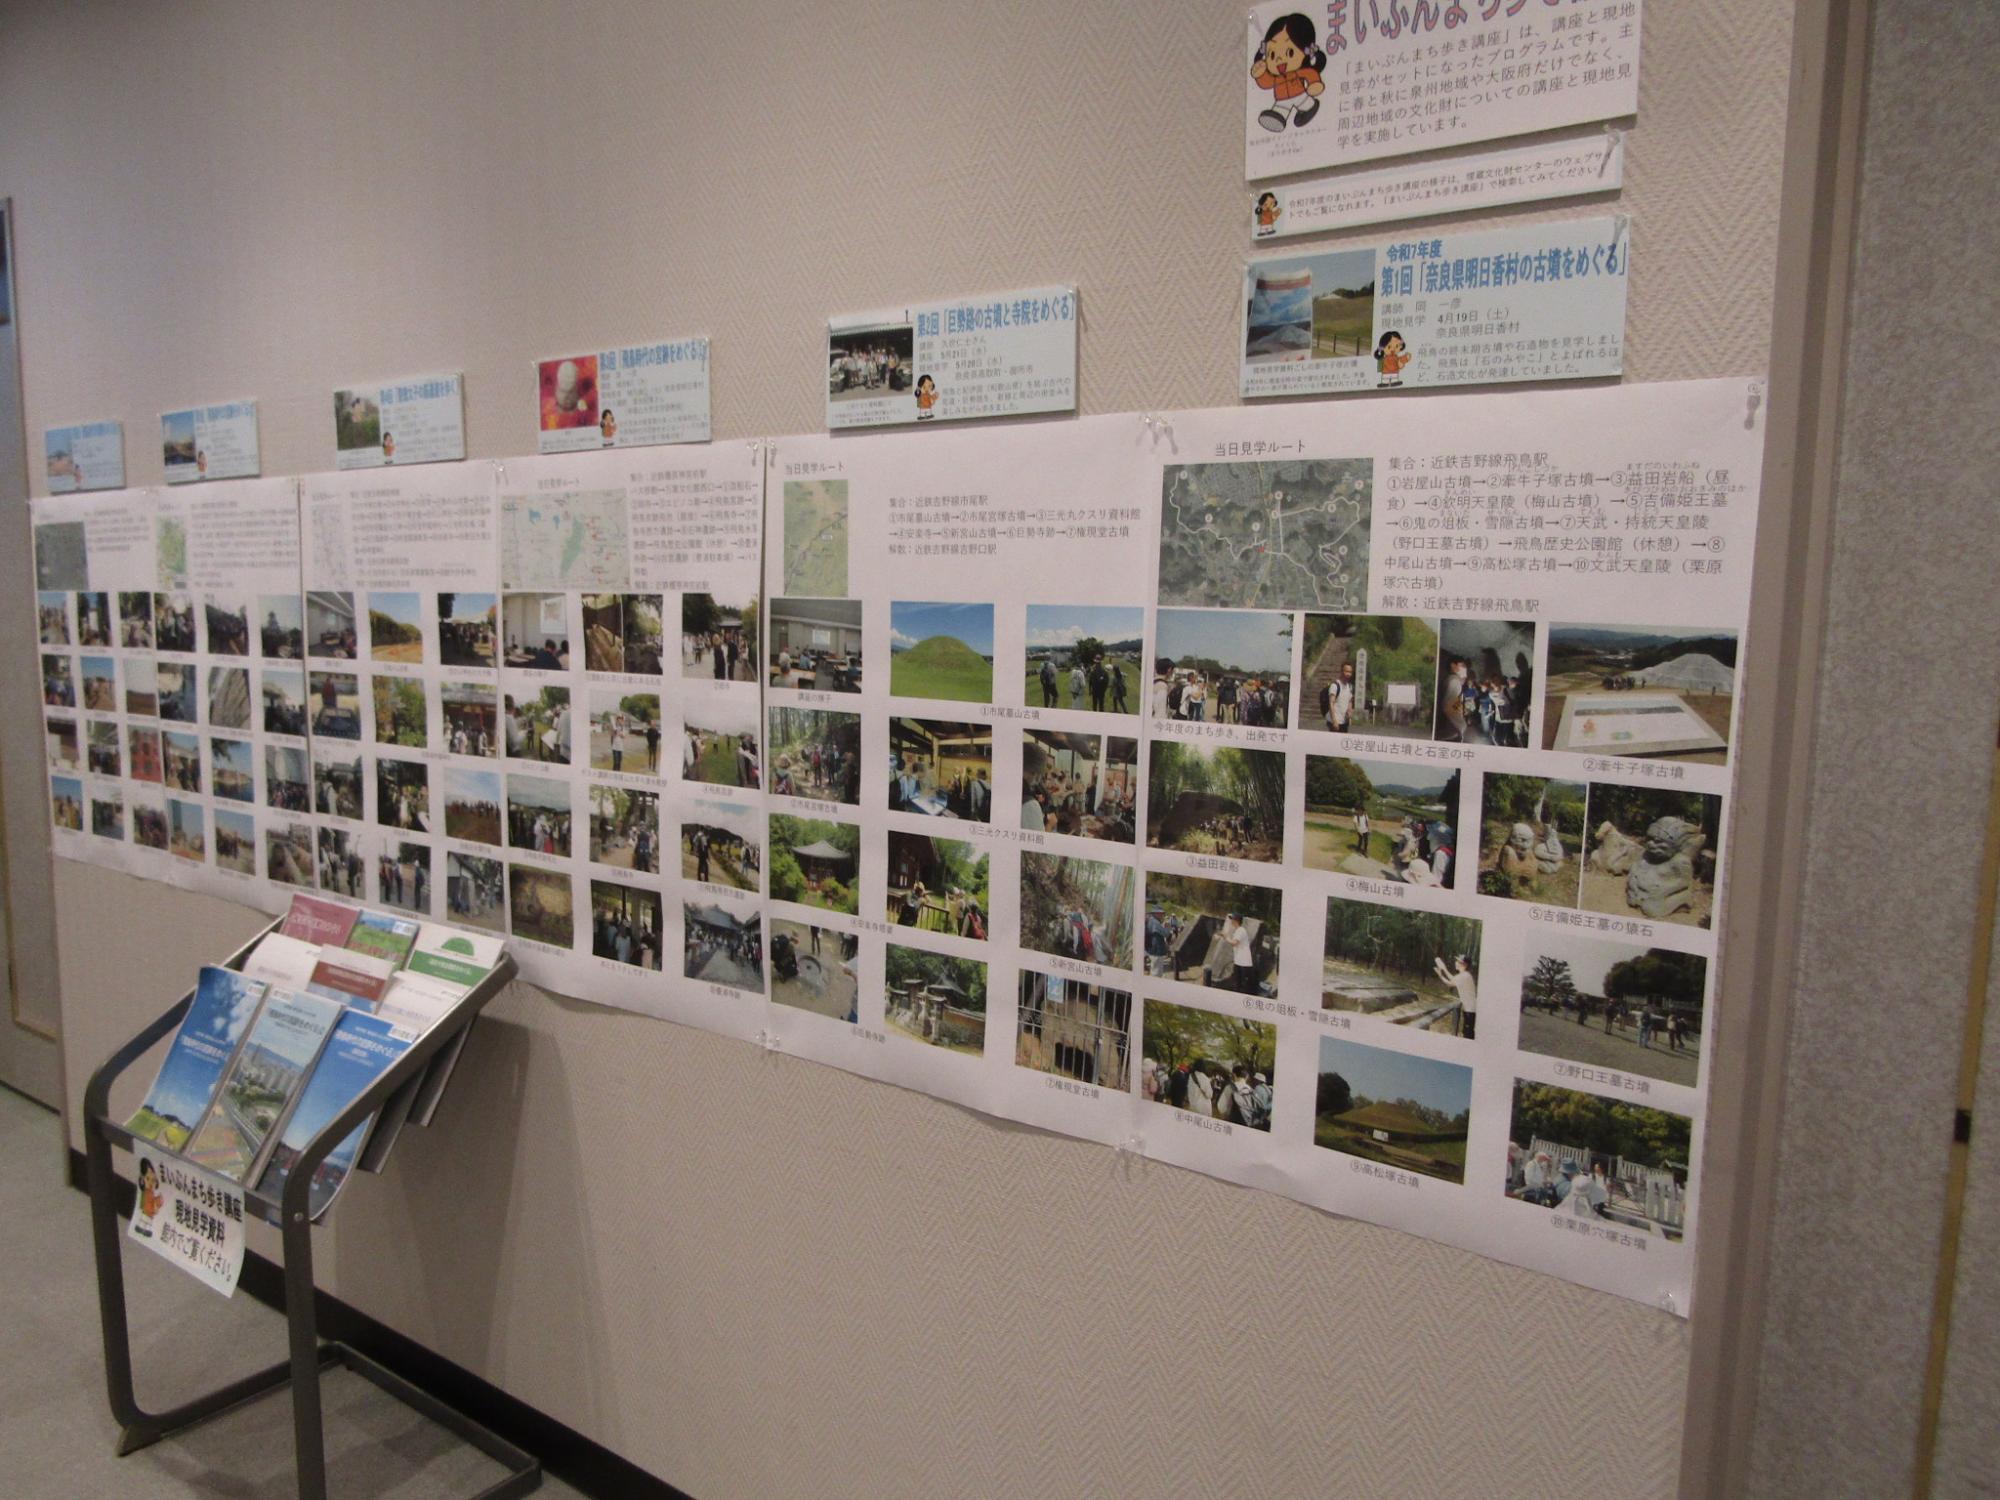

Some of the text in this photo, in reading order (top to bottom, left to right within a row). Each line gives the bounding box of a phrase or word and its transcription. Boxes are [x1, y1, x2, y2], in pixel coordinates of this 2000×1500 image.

[1339, 23, 1634, 95] 見学がセットになったプログラムです。主
[1337, 62, 1632, 132] 周辺地域の文化財についての講座と現地見
[1336, 118, 1468, 149] 学を実施しています。
[1386, 239, 1443, 262] 令和7年度
[1215, 440, 1306, 457] 当日見学ルート
[784, 462, 845, 475] 当日見学ルート
[1389, 453, 1549, 470] 集合：近鉄吉野線飛鳥駅
[1382, 596, 1540, 613] 解散：近鉄吉野線飛鳥駅
[1154, 722, 1288, 743] 今年度のまち歩き、出発です
